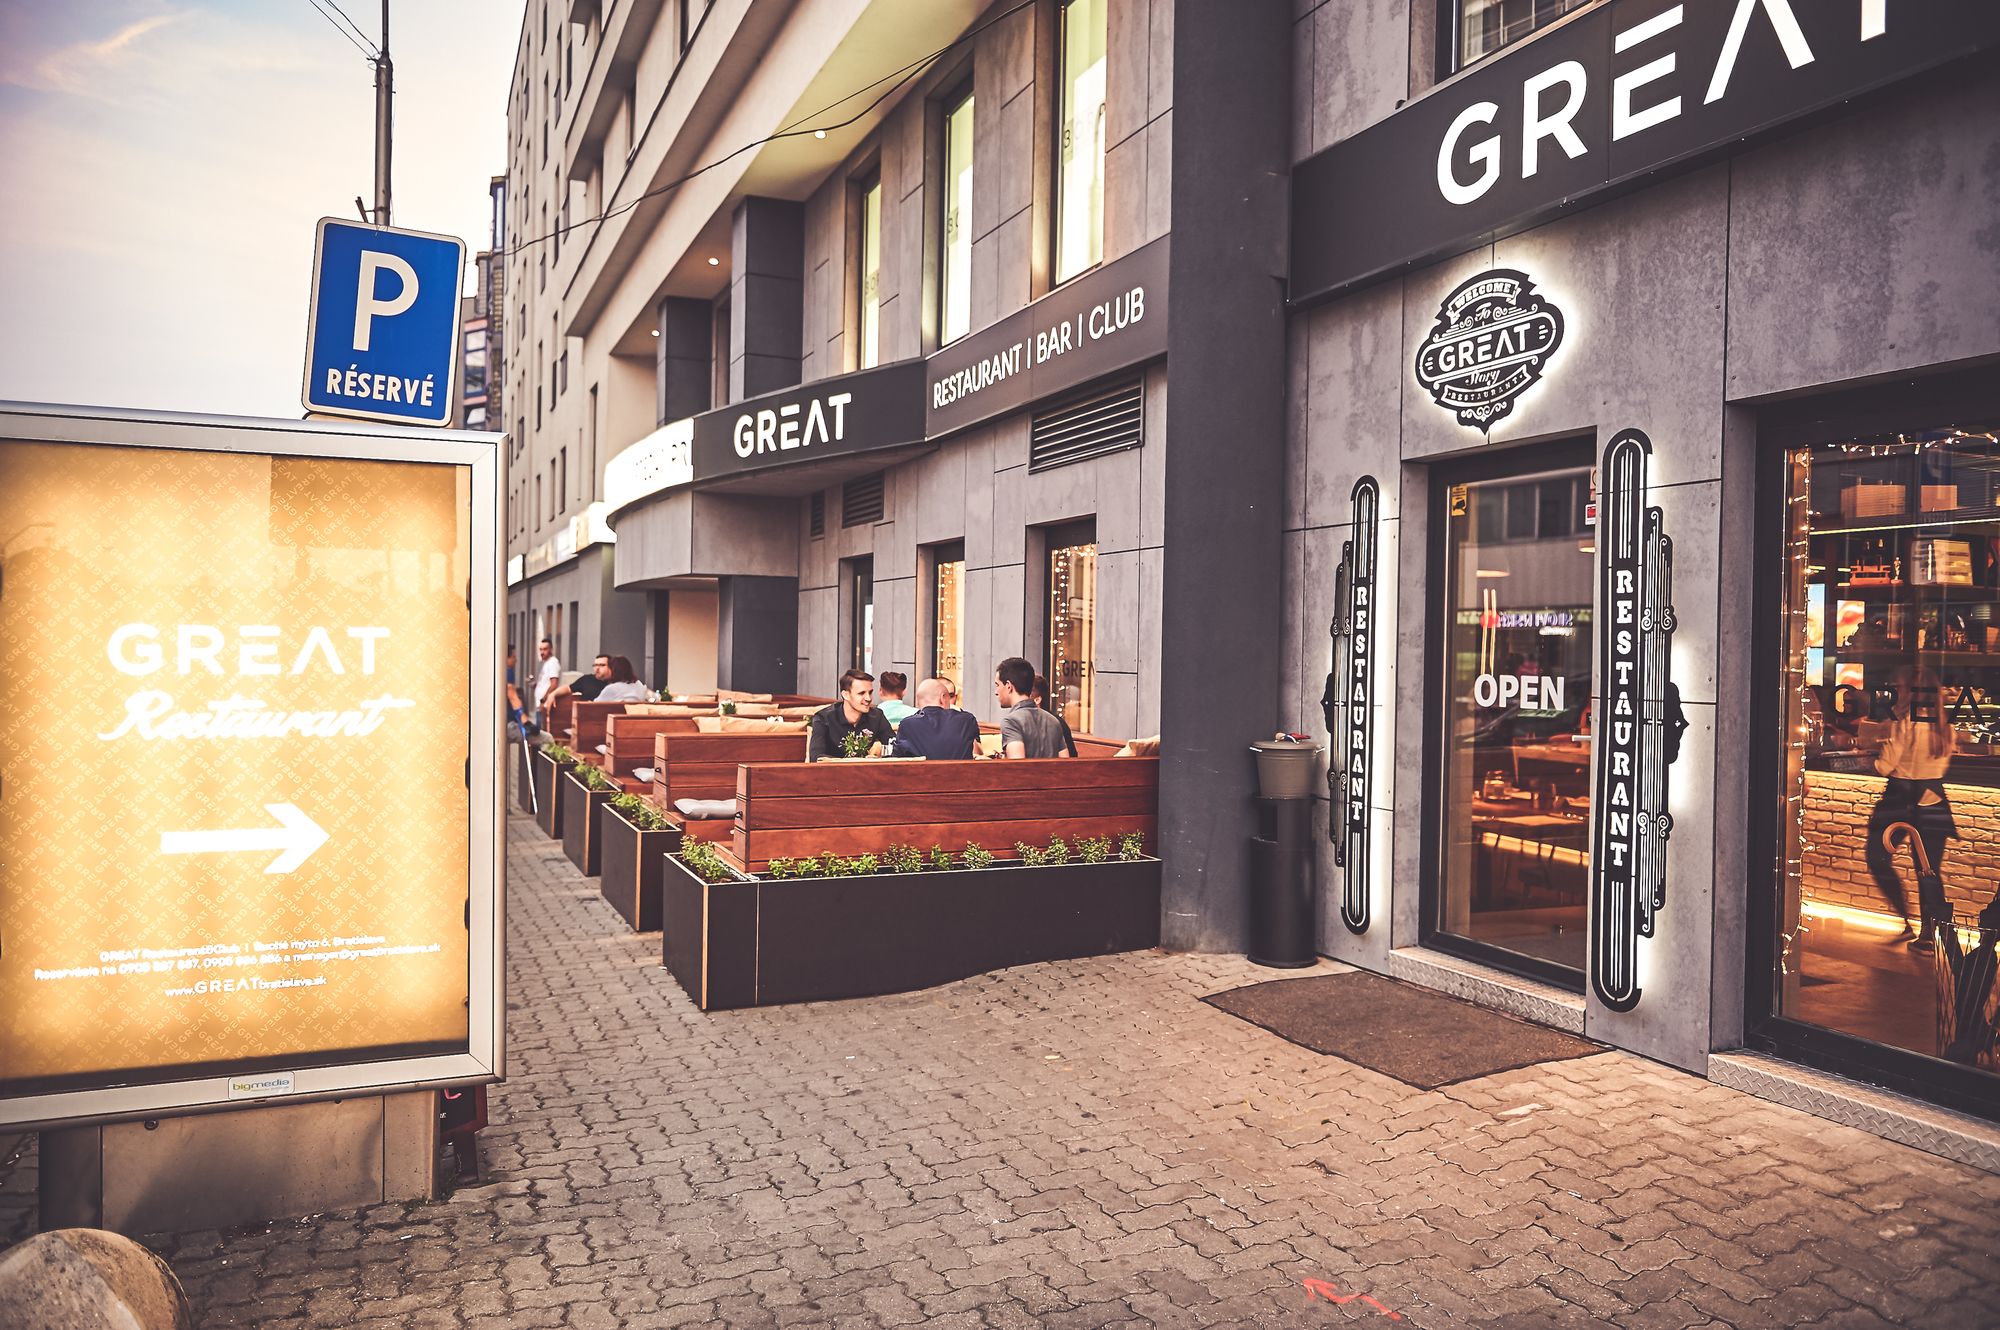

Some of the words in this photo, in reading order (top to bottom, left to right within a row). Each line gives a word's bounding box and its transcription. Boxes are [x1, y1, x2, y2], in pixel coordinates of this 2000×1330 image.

[353, 250, 419, 352] P
[1455, 281, 1512, 309] WELCOME
[933, 343, 1022, 409] RESTAURANT
[1036, 321, 1073, 364] BAR
[1088, 286, 1145, 340] CLUB
[1438, 323, 1531, 372] GREAT
[326, 364, 434, 407] RÉSERVÉ
[1451, 379, 1518, 401] RESTAURANT
[734, 392, 852, 458] GREAT
[107, 622, 391, 676] GREAT
[97, 689, 417, 741] Restaurant
[1351, 586, 1368, 821] RESTAURANT
[1474, 674, 1565, 710] OPEN
[1610, 569, 1633, 866] RESTAURANT
[232, 1079, 290, 1092] bigmedia
